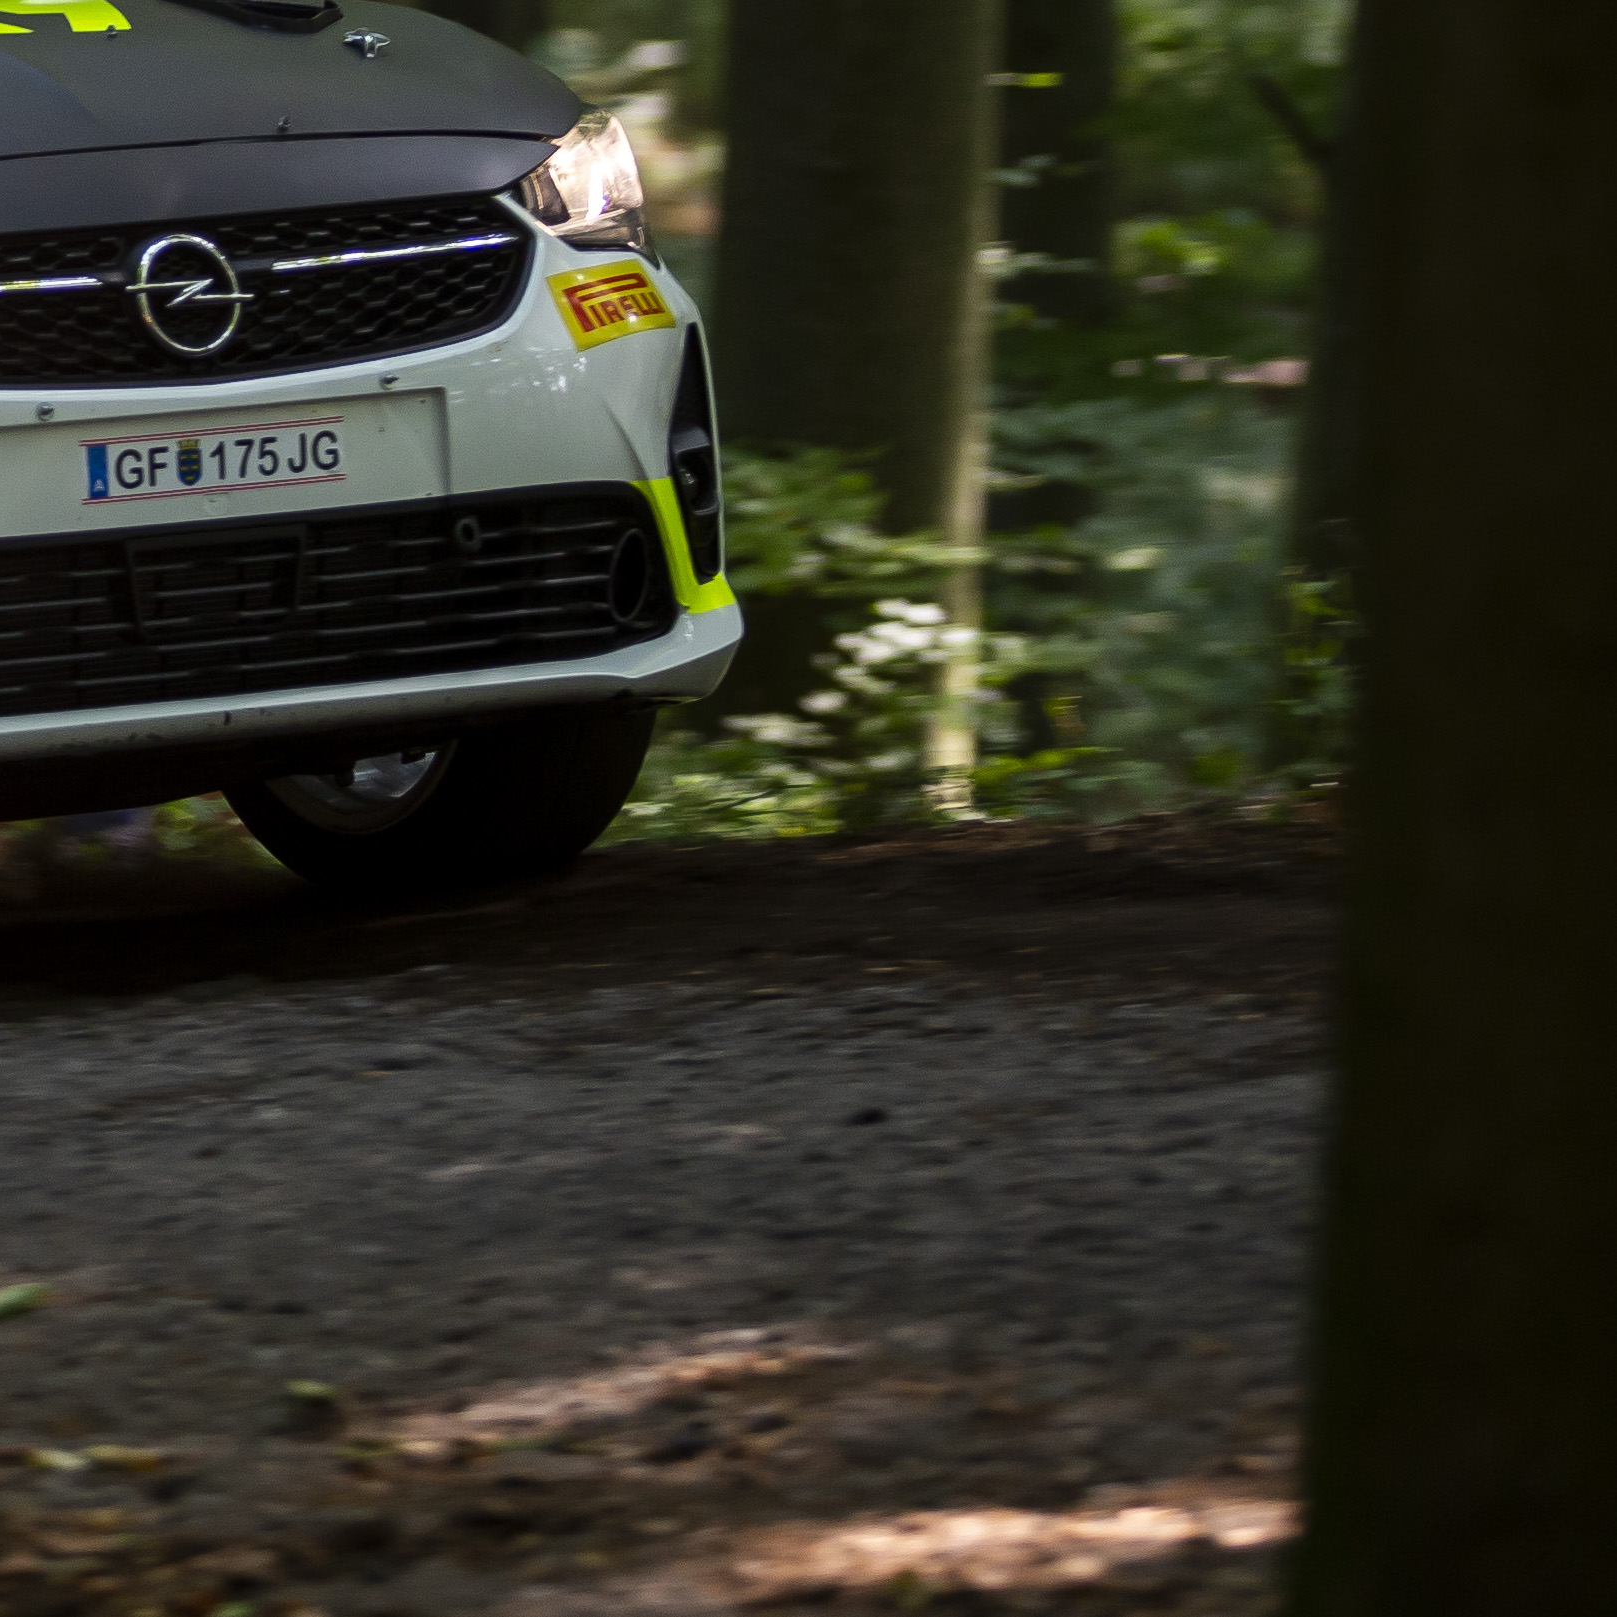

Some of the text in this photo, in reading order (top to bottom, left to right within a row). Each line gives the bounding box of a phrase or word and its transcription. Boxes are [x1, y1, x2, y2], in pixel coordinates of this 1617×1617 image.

[562, 272, 666, 333] PIRELLI
[114, 430, 341, 490] GF 175 JG
